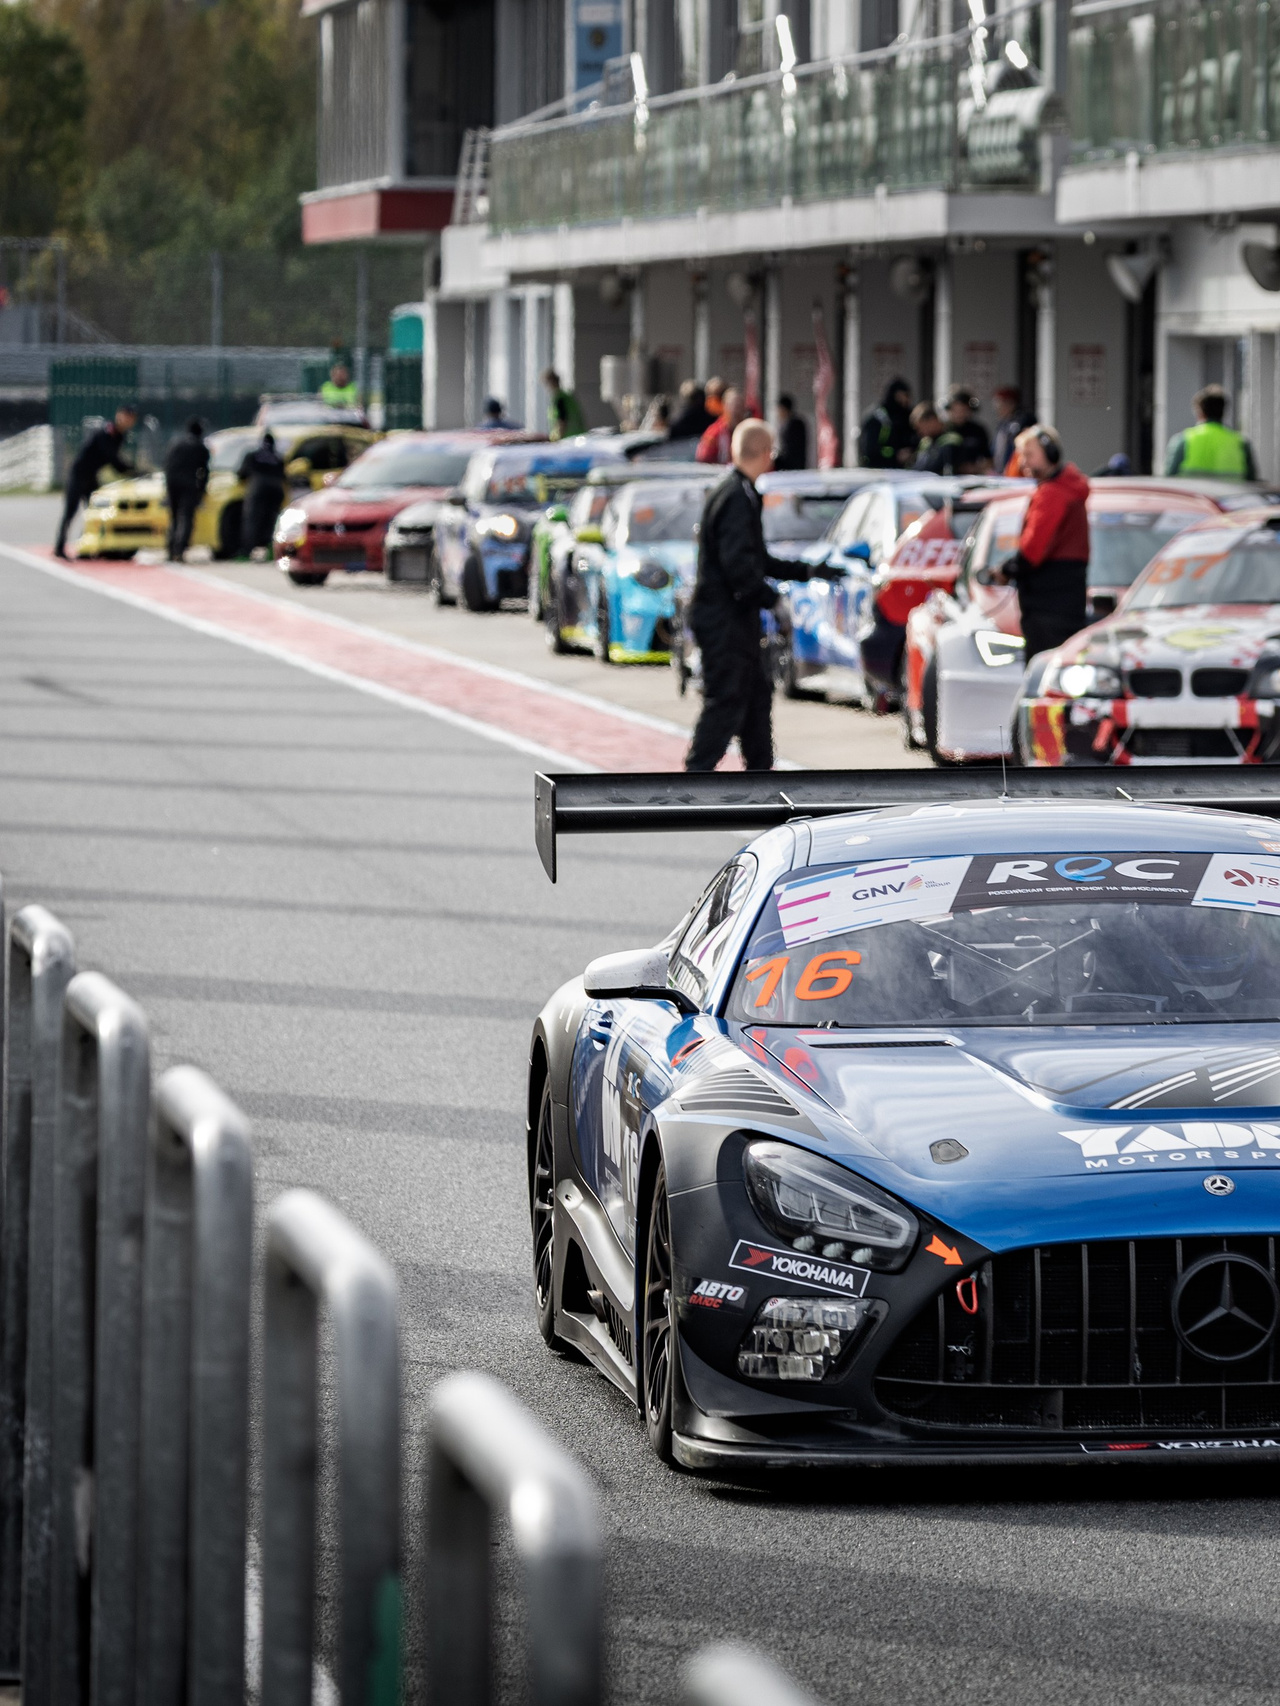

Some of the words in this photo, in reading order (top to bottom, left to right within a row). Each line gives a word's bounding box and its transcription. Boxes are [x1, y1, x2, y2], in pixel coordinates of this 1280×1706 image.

[852, 881, 906, 901] GNV
[988, 887, 1043, 896] РОССИЙСКАЯ
[1122, 886, 1189, 894] ВЫНОСЛИВОСТЬ
[745, 950, 862, 1008] 16
[771, 1255, 854, 1289] YOKOHAMA
[694, 1280, 745, 1301] АВТО
